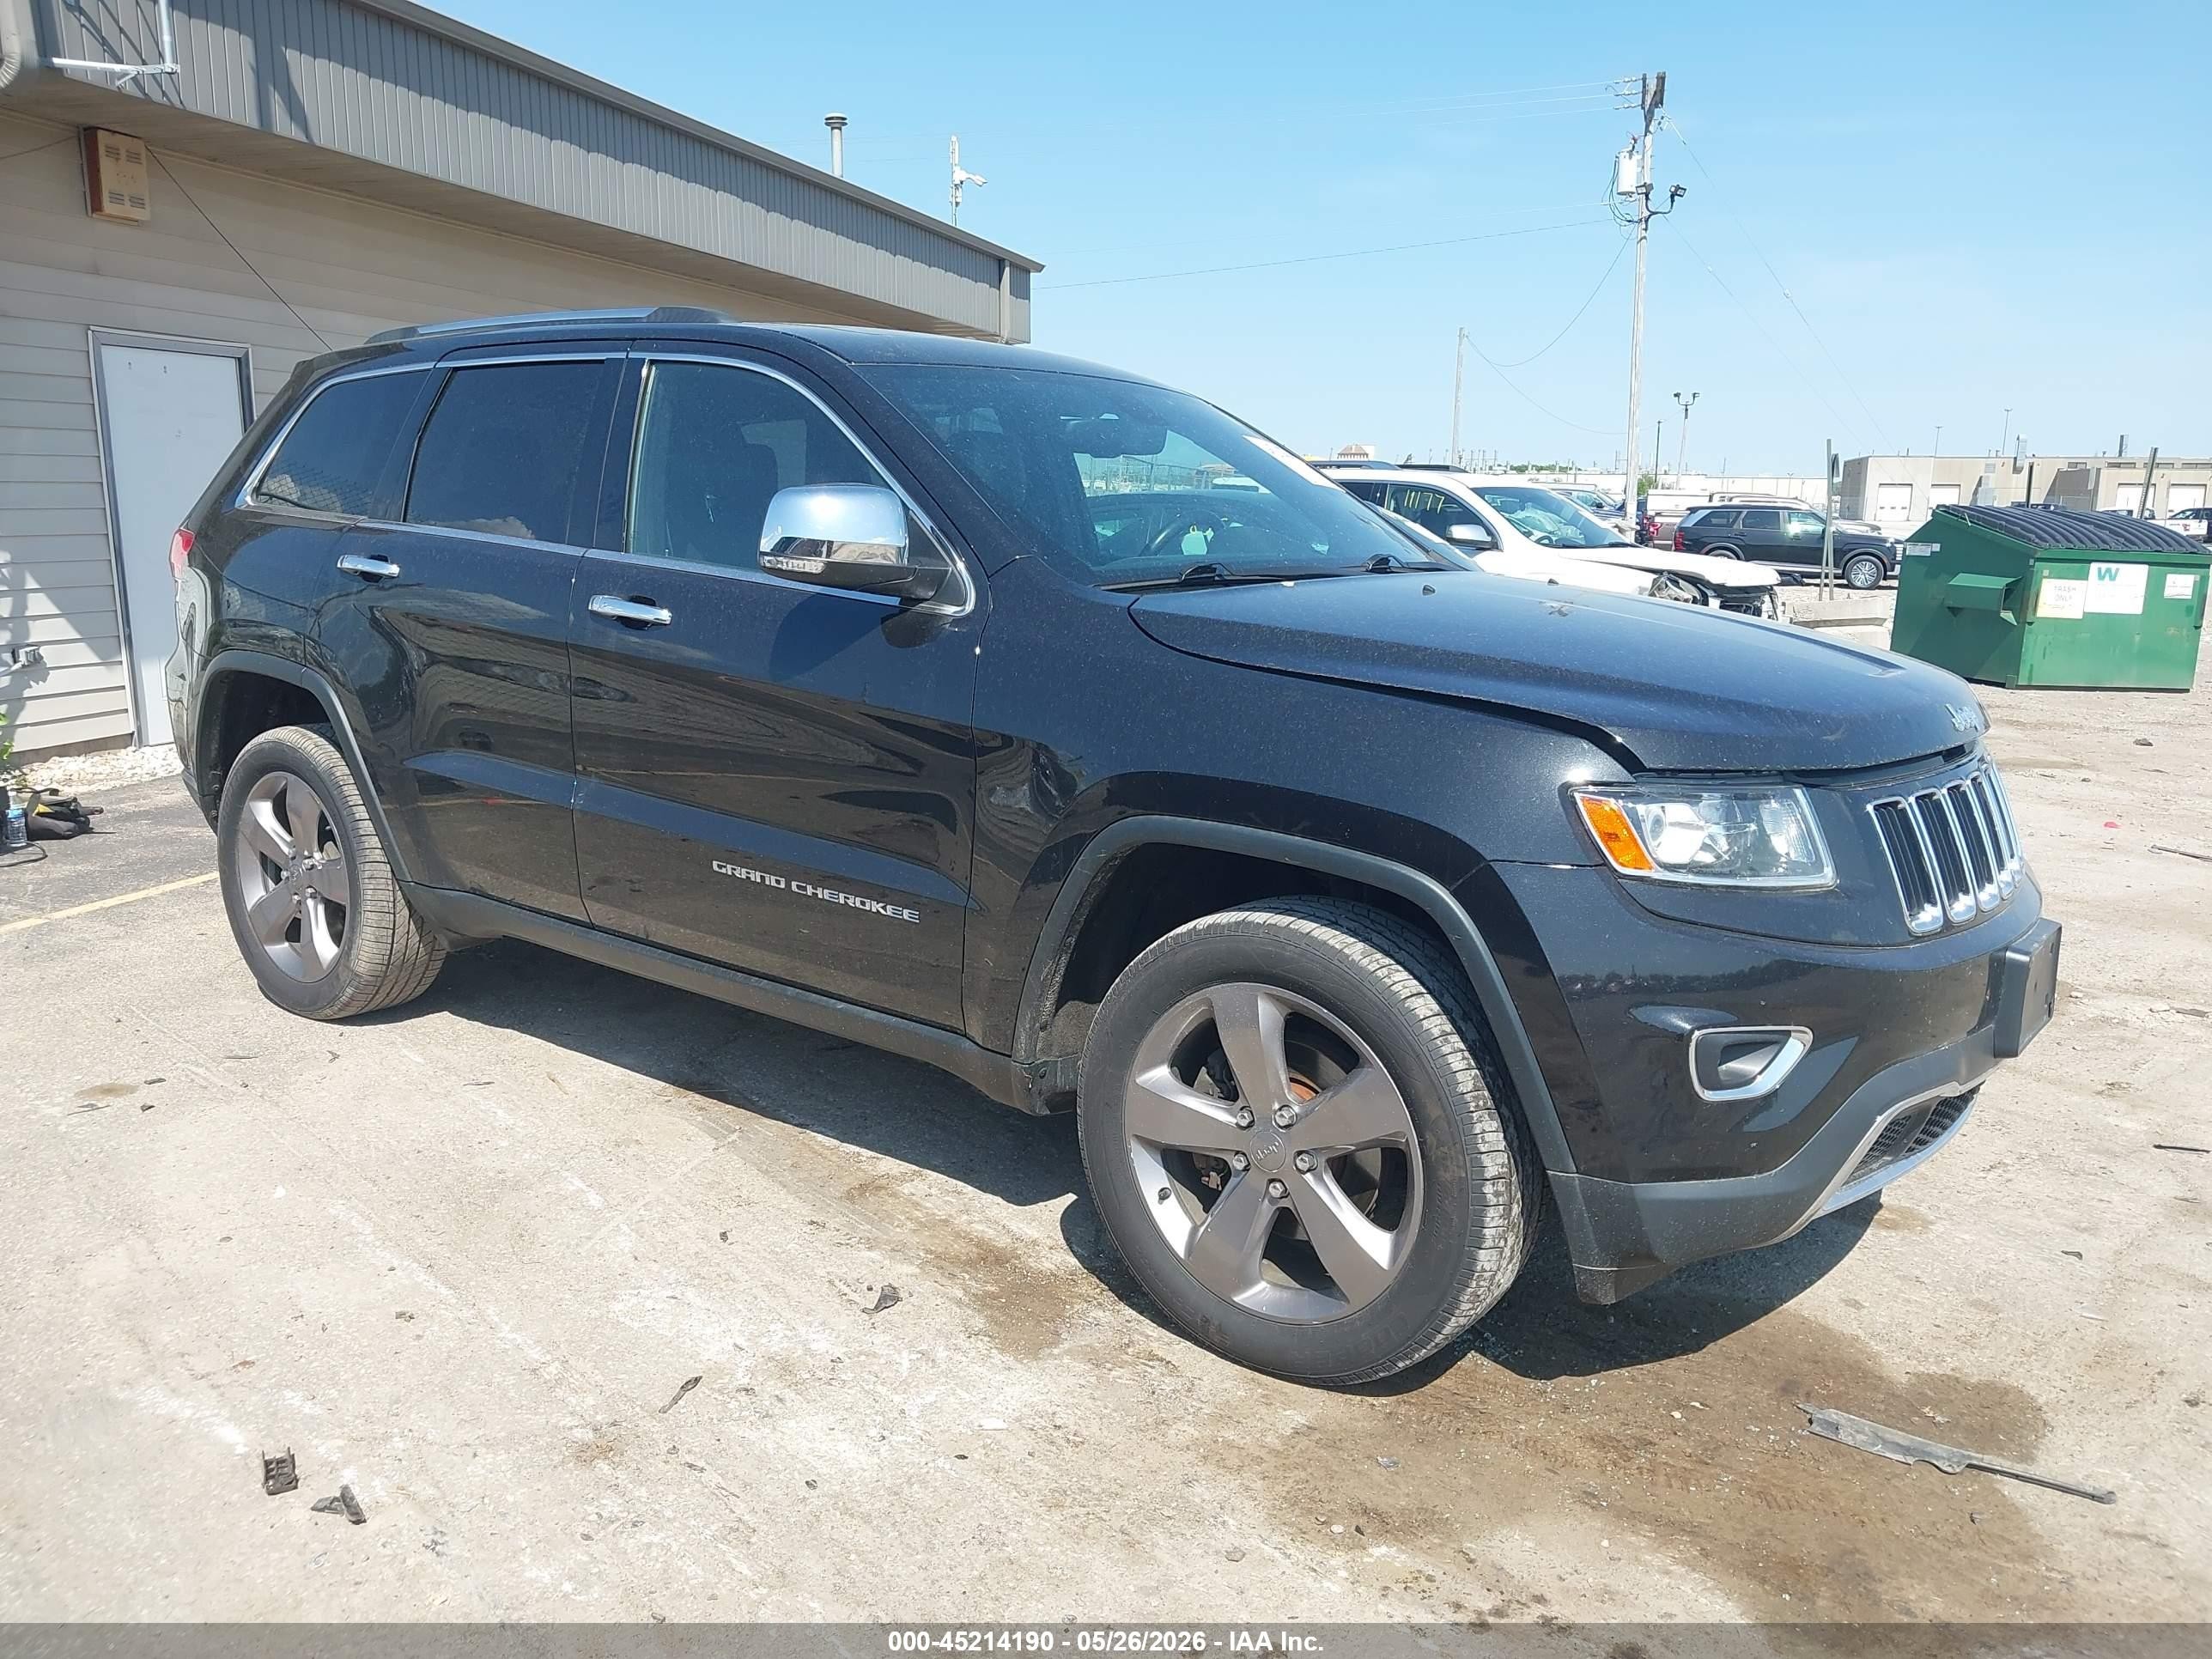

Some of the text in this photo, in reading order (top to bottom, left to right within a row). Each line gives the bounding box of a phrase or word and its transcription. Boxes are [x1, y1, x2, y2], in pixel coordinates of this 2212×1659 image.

[1404, 489, 1445, 515] 11177
[712, 860, 921, 924] GRAND CHEROKEE
